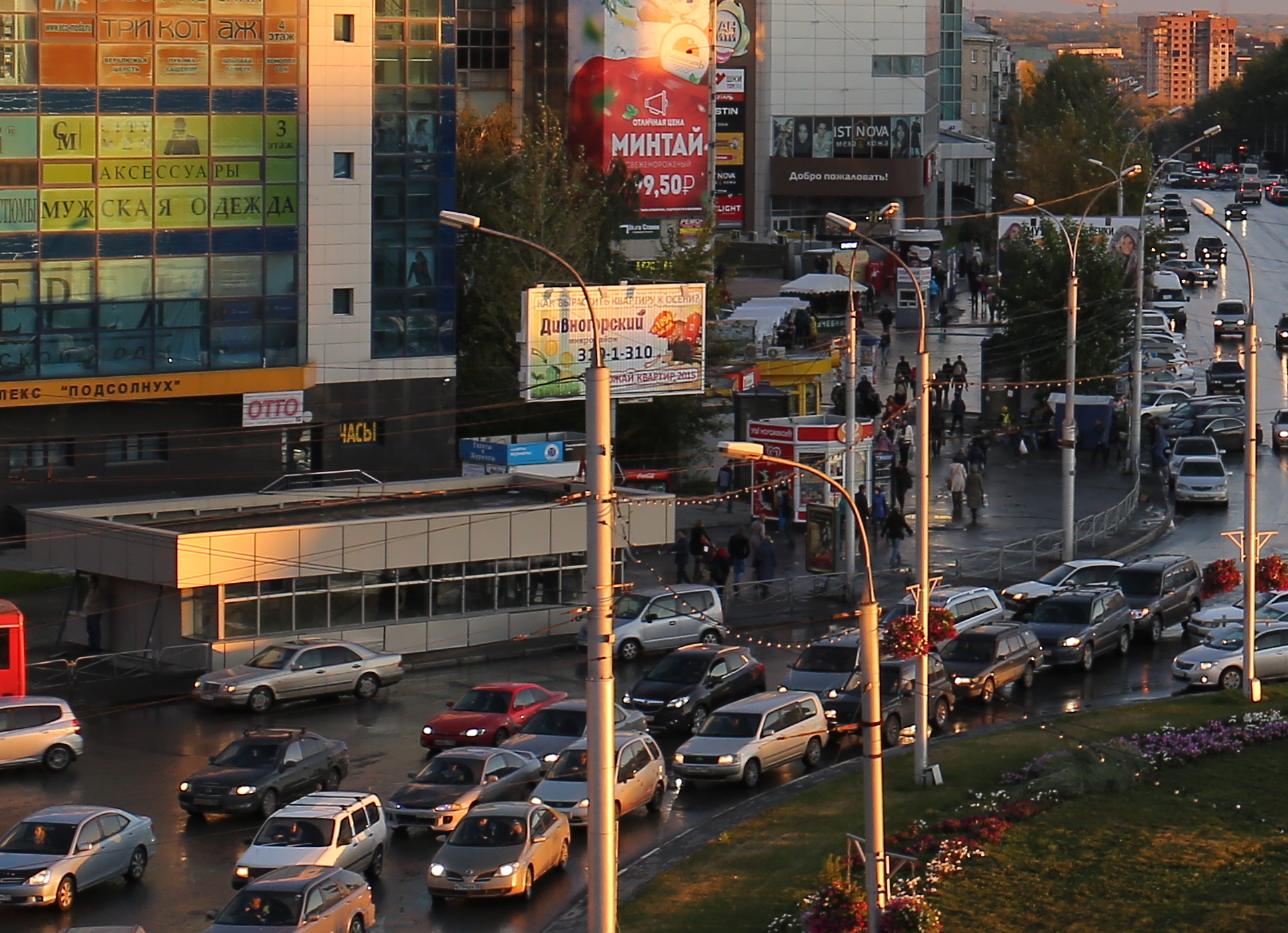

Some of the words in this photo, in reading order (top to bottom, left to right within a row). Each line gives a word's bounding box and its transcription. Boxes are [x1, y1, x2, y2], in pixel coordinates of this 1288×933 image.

[278, 21, 285, 29] 4
[268, 33, 296, 41] этаж
[276, 120, 287, 137] 3
[633, 118, 667, 126] ОТЛИЧНАЯ
[668, 118, 685, 126] ЦЕНА
[856, 126, 889, 137] NOVA
[612, 126, 703, 157] МИНТАЙ
[100, 164, 240, 180] АКСЕССУАРЫ
[789, 172, 822, 182] Добро
[824, 173, 889, 182] пожаловать!
[42, 198, 171, 219] МУЖСКАЯ
[191, 195, 296, 219] ОДЕЖДА
[340, 421, 377, 443] ЧАСЫ
